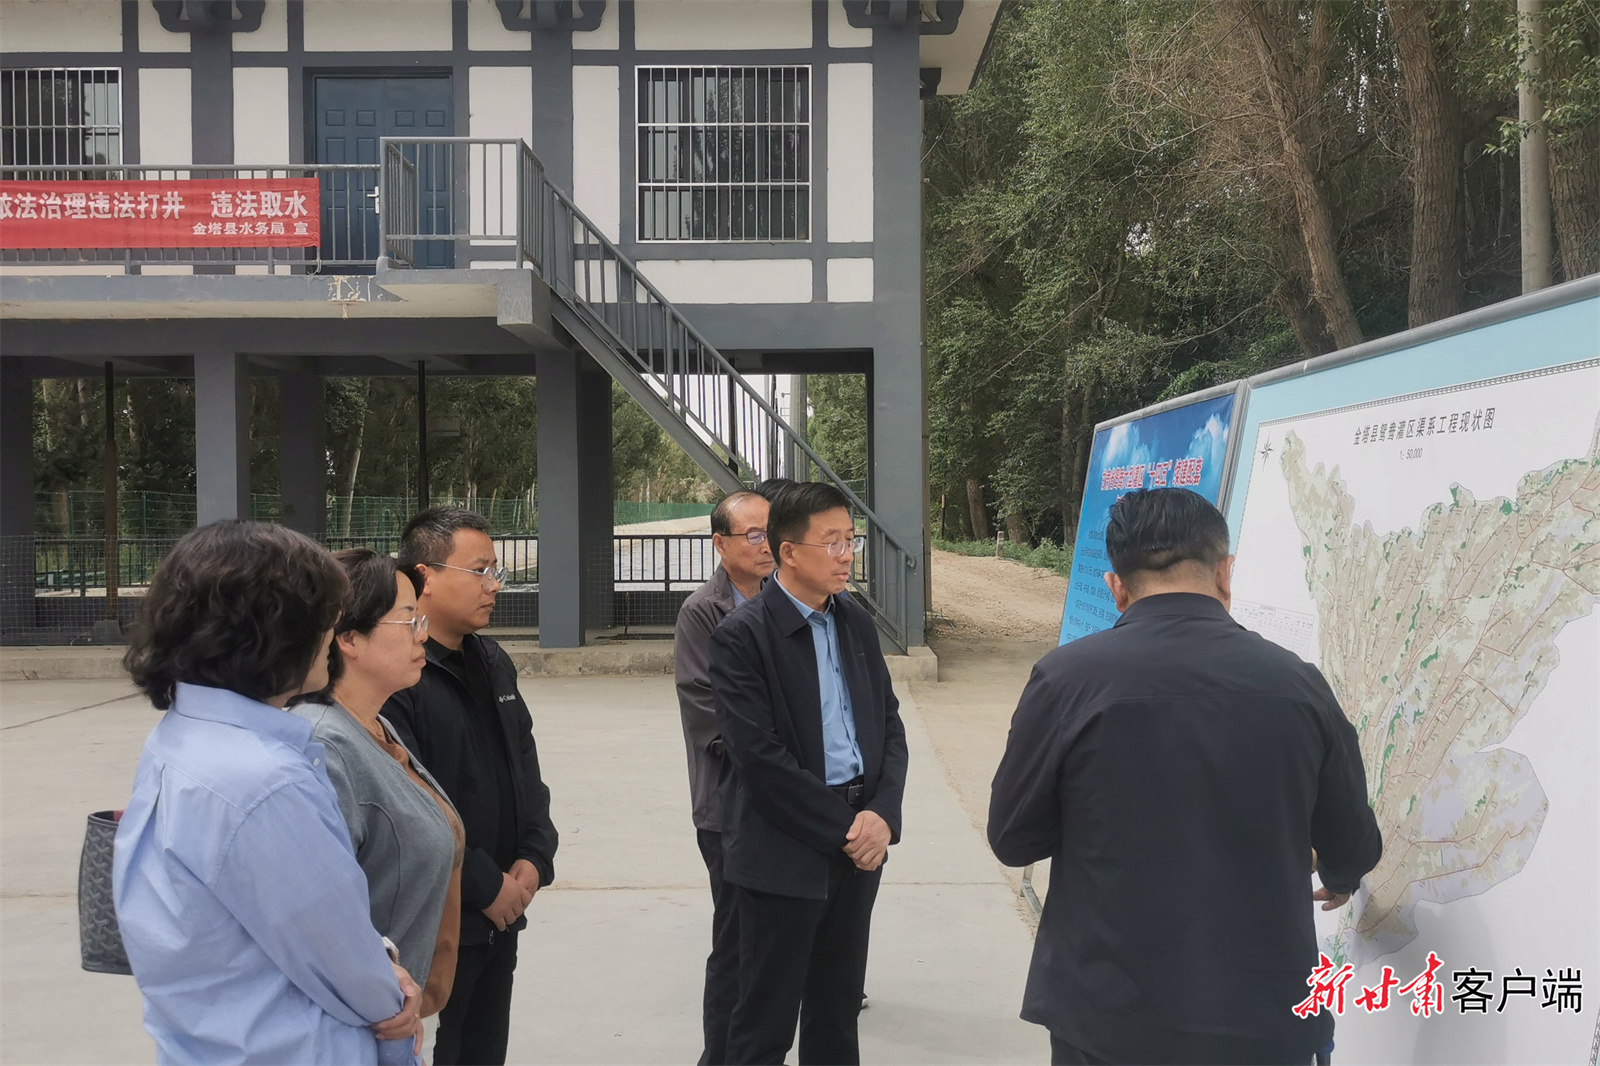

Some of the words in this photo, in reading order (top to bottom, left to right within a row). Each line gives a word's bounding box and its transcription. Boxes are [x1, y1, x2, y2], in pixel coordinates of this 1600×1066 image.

[210, 190, 308, 219] 违法取水
[192, 221, 285, 236] 金塔县水务局
[293, 221, 309, 236] 宣
[1353, 407, 1496, 445] 金塔县鸳鸯灌区渠系工程现状图
